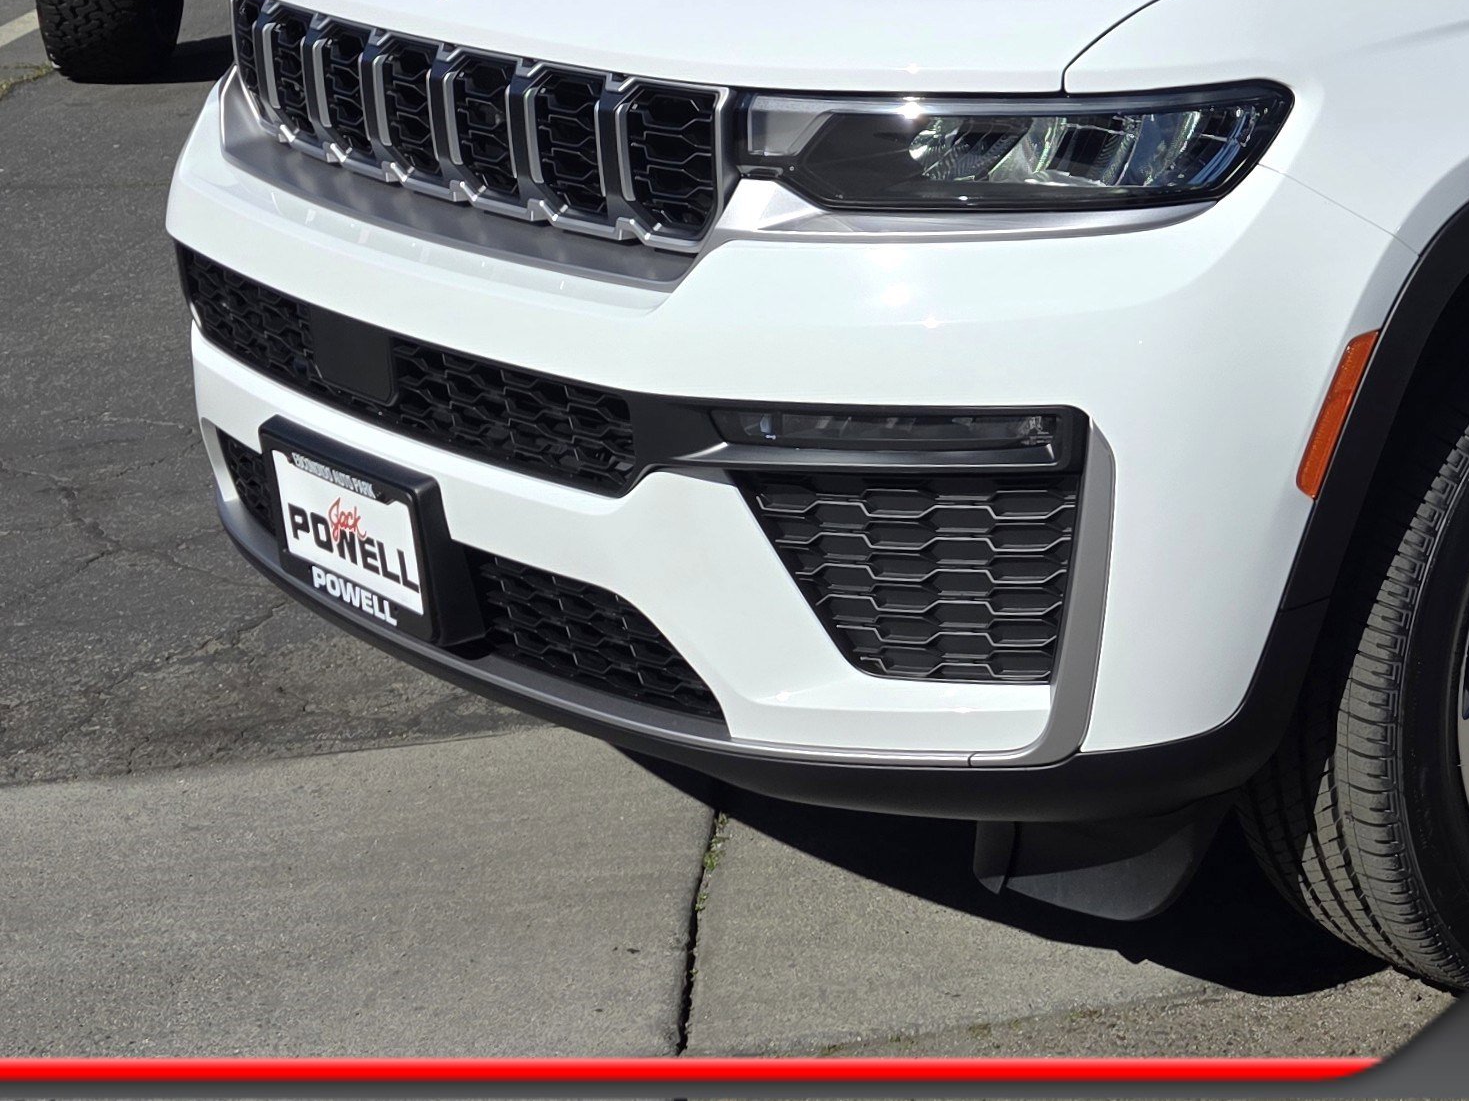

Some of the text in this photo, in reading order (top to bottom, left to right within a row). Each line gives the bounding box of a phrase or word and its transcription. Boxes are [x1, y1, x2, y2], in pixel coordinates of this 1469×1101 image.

[288, 502, 420, 593] POWELL
[328, 497, 367, 543] Jack
[312, 566, 398, 626] POWELL
